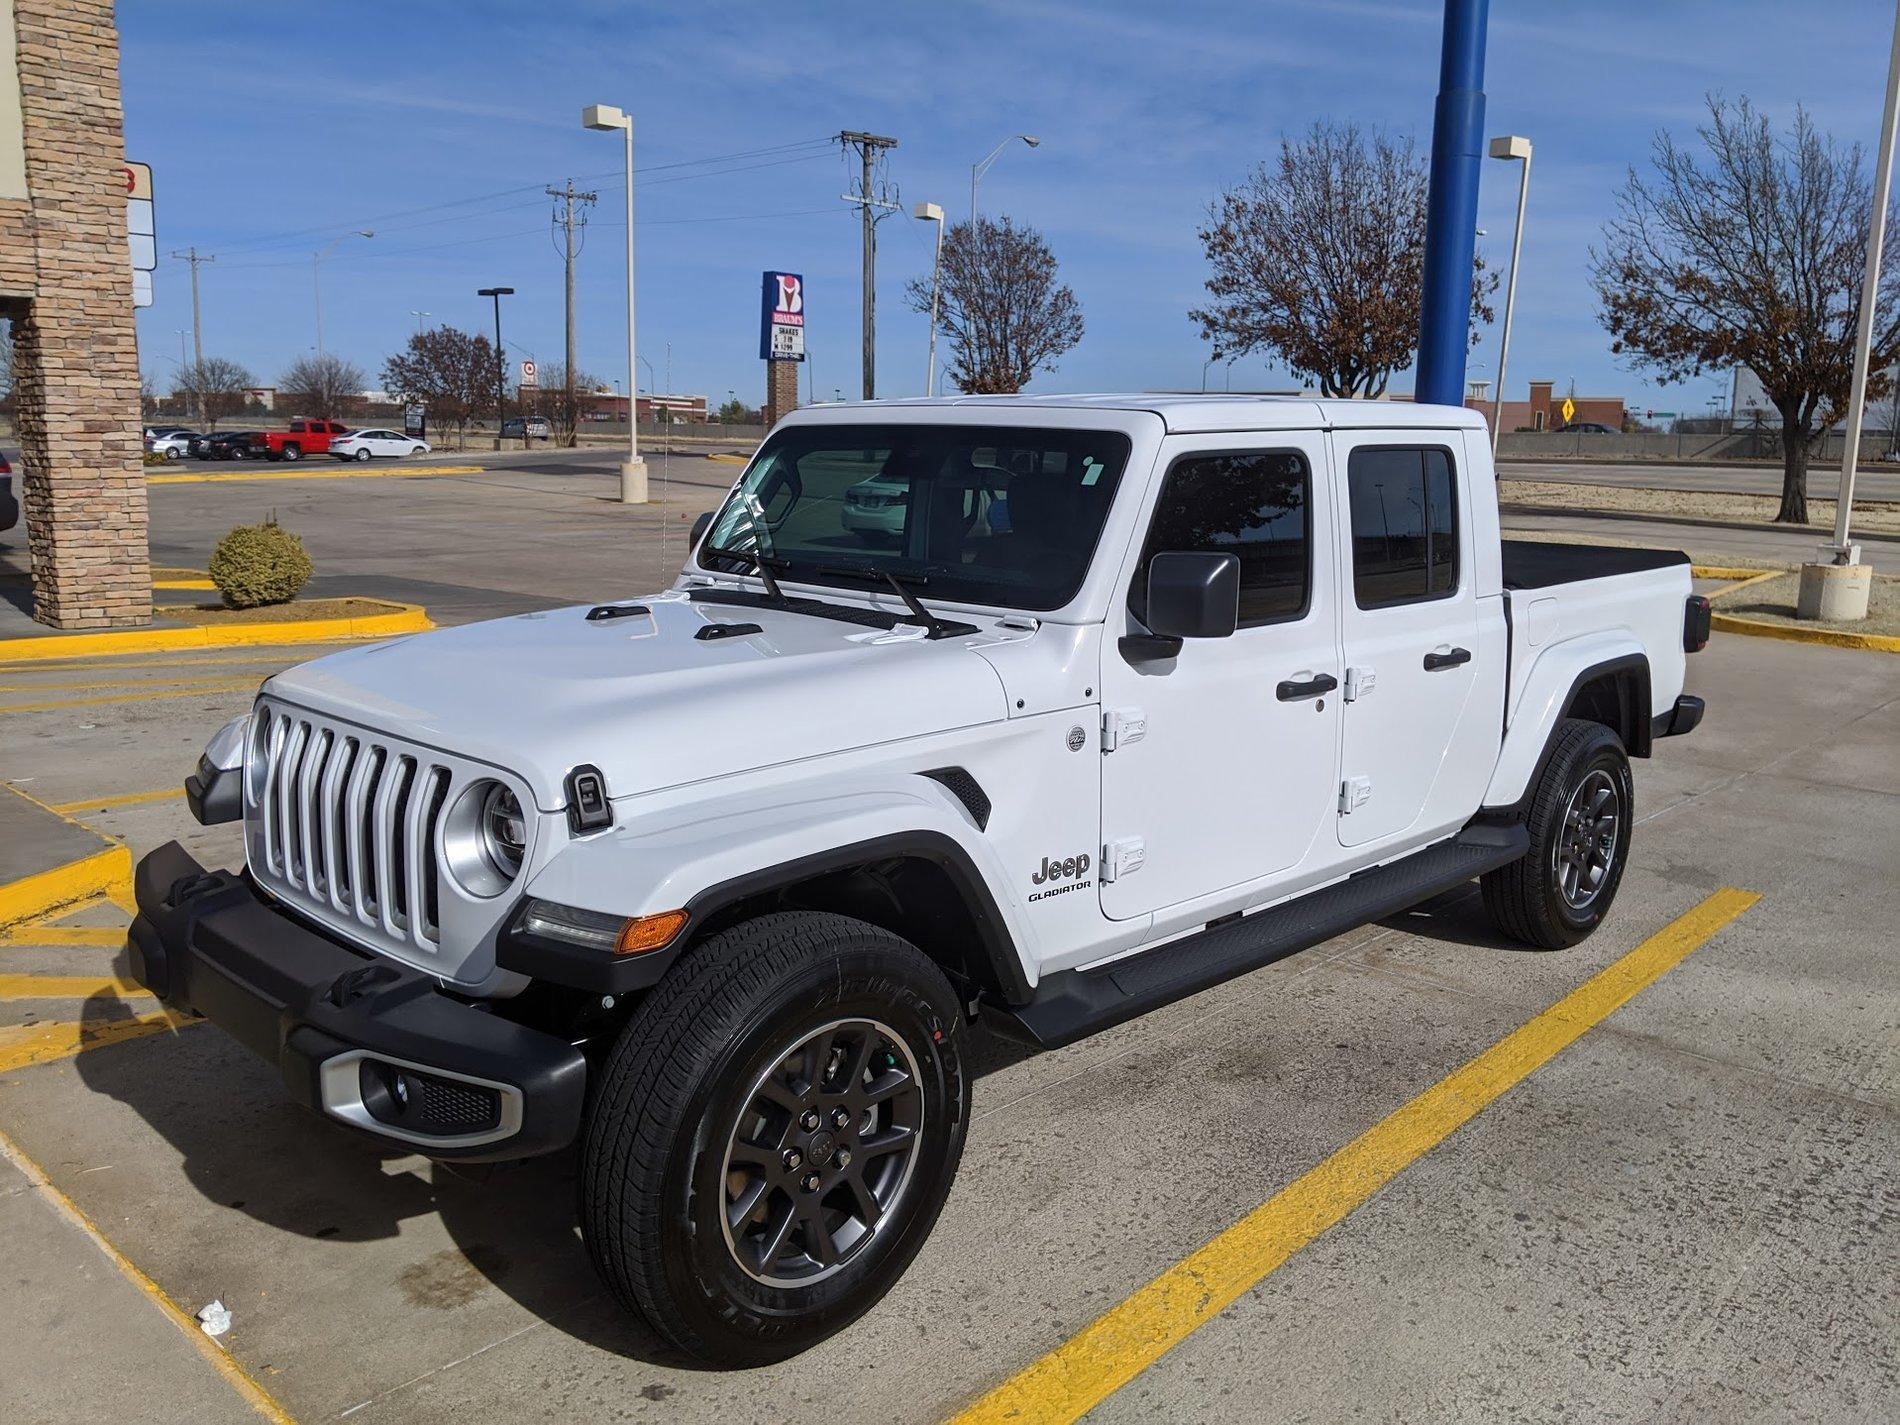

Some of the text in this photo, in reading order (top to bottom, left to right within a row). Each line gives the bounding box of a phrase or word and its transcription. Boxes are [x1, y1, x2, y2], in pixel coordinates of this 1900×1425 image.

[779, 327, 799, 336] SHAKES
[1032, 853, 1090, 885] Jeep
[1028, 880, 1091, 902] GLADIATOR
